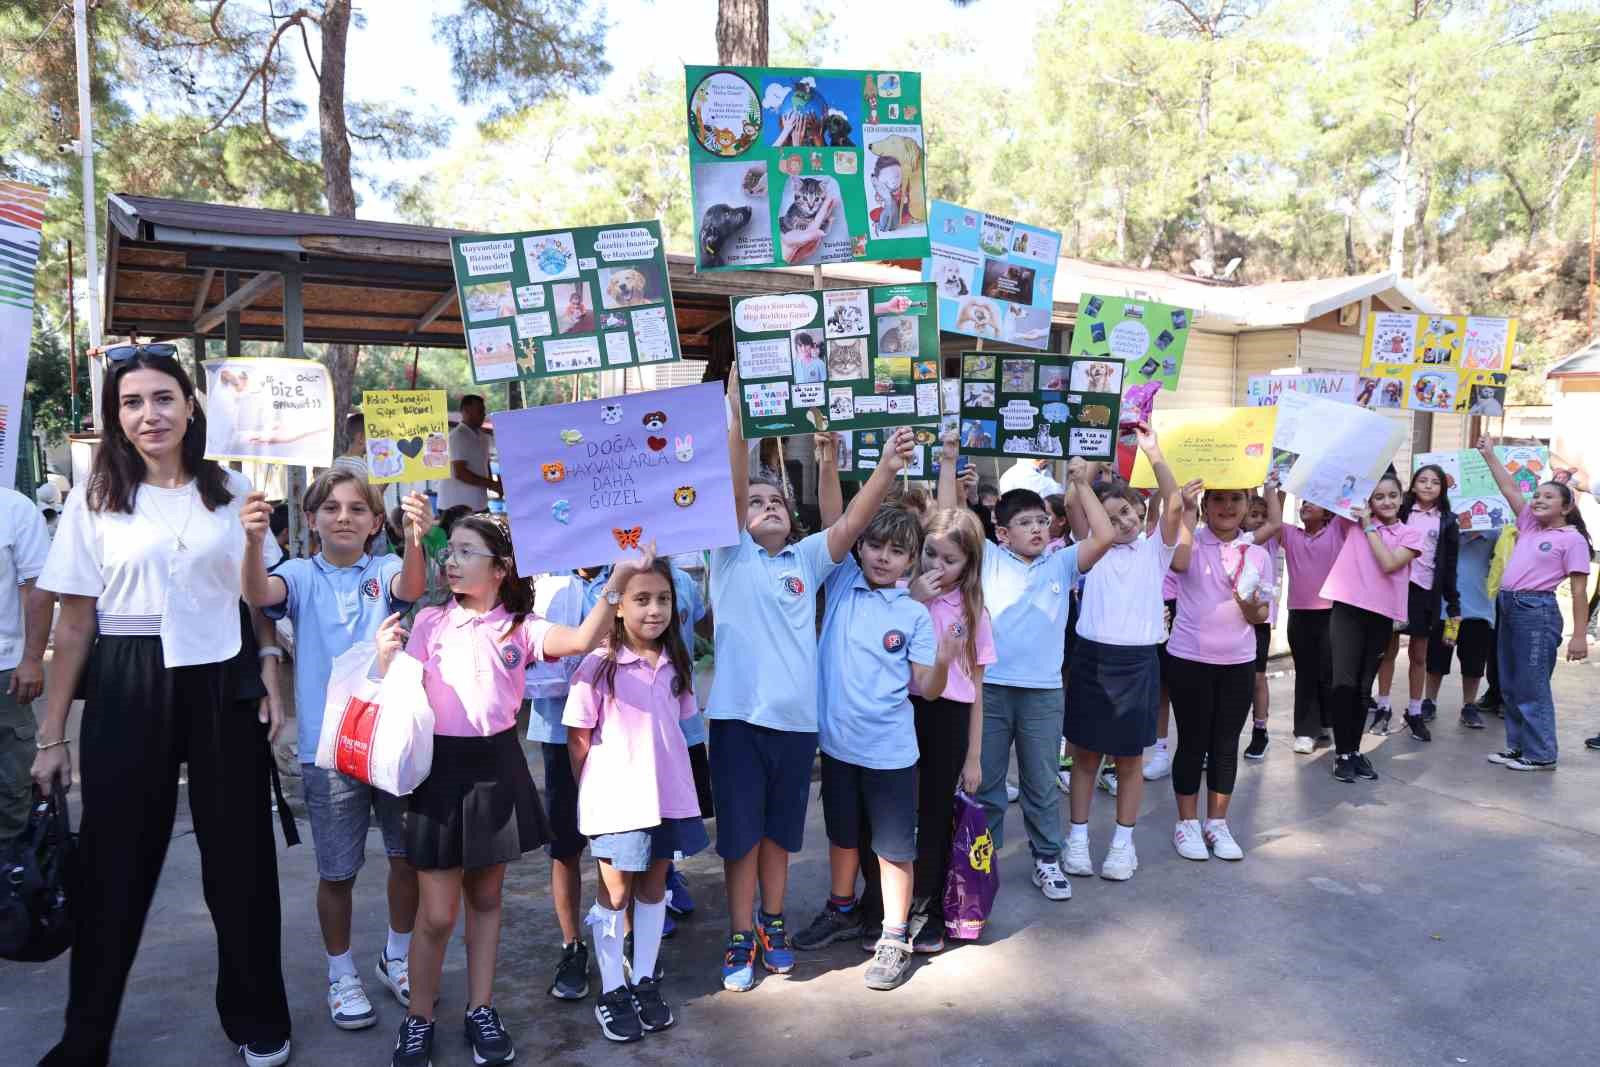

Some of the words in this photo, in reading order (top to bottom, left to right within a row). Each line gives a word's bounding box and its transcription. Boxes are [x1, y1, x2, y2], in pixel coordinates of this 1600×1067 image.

[271, 382, 305, 397] bize
[586, 433, 638, 458] DOĞA
[565, 451, 670, 477] HAYVANLARLA
[592, 471, 636, 492] DAHA
[588, 489, 643, 509] GÜZEL
